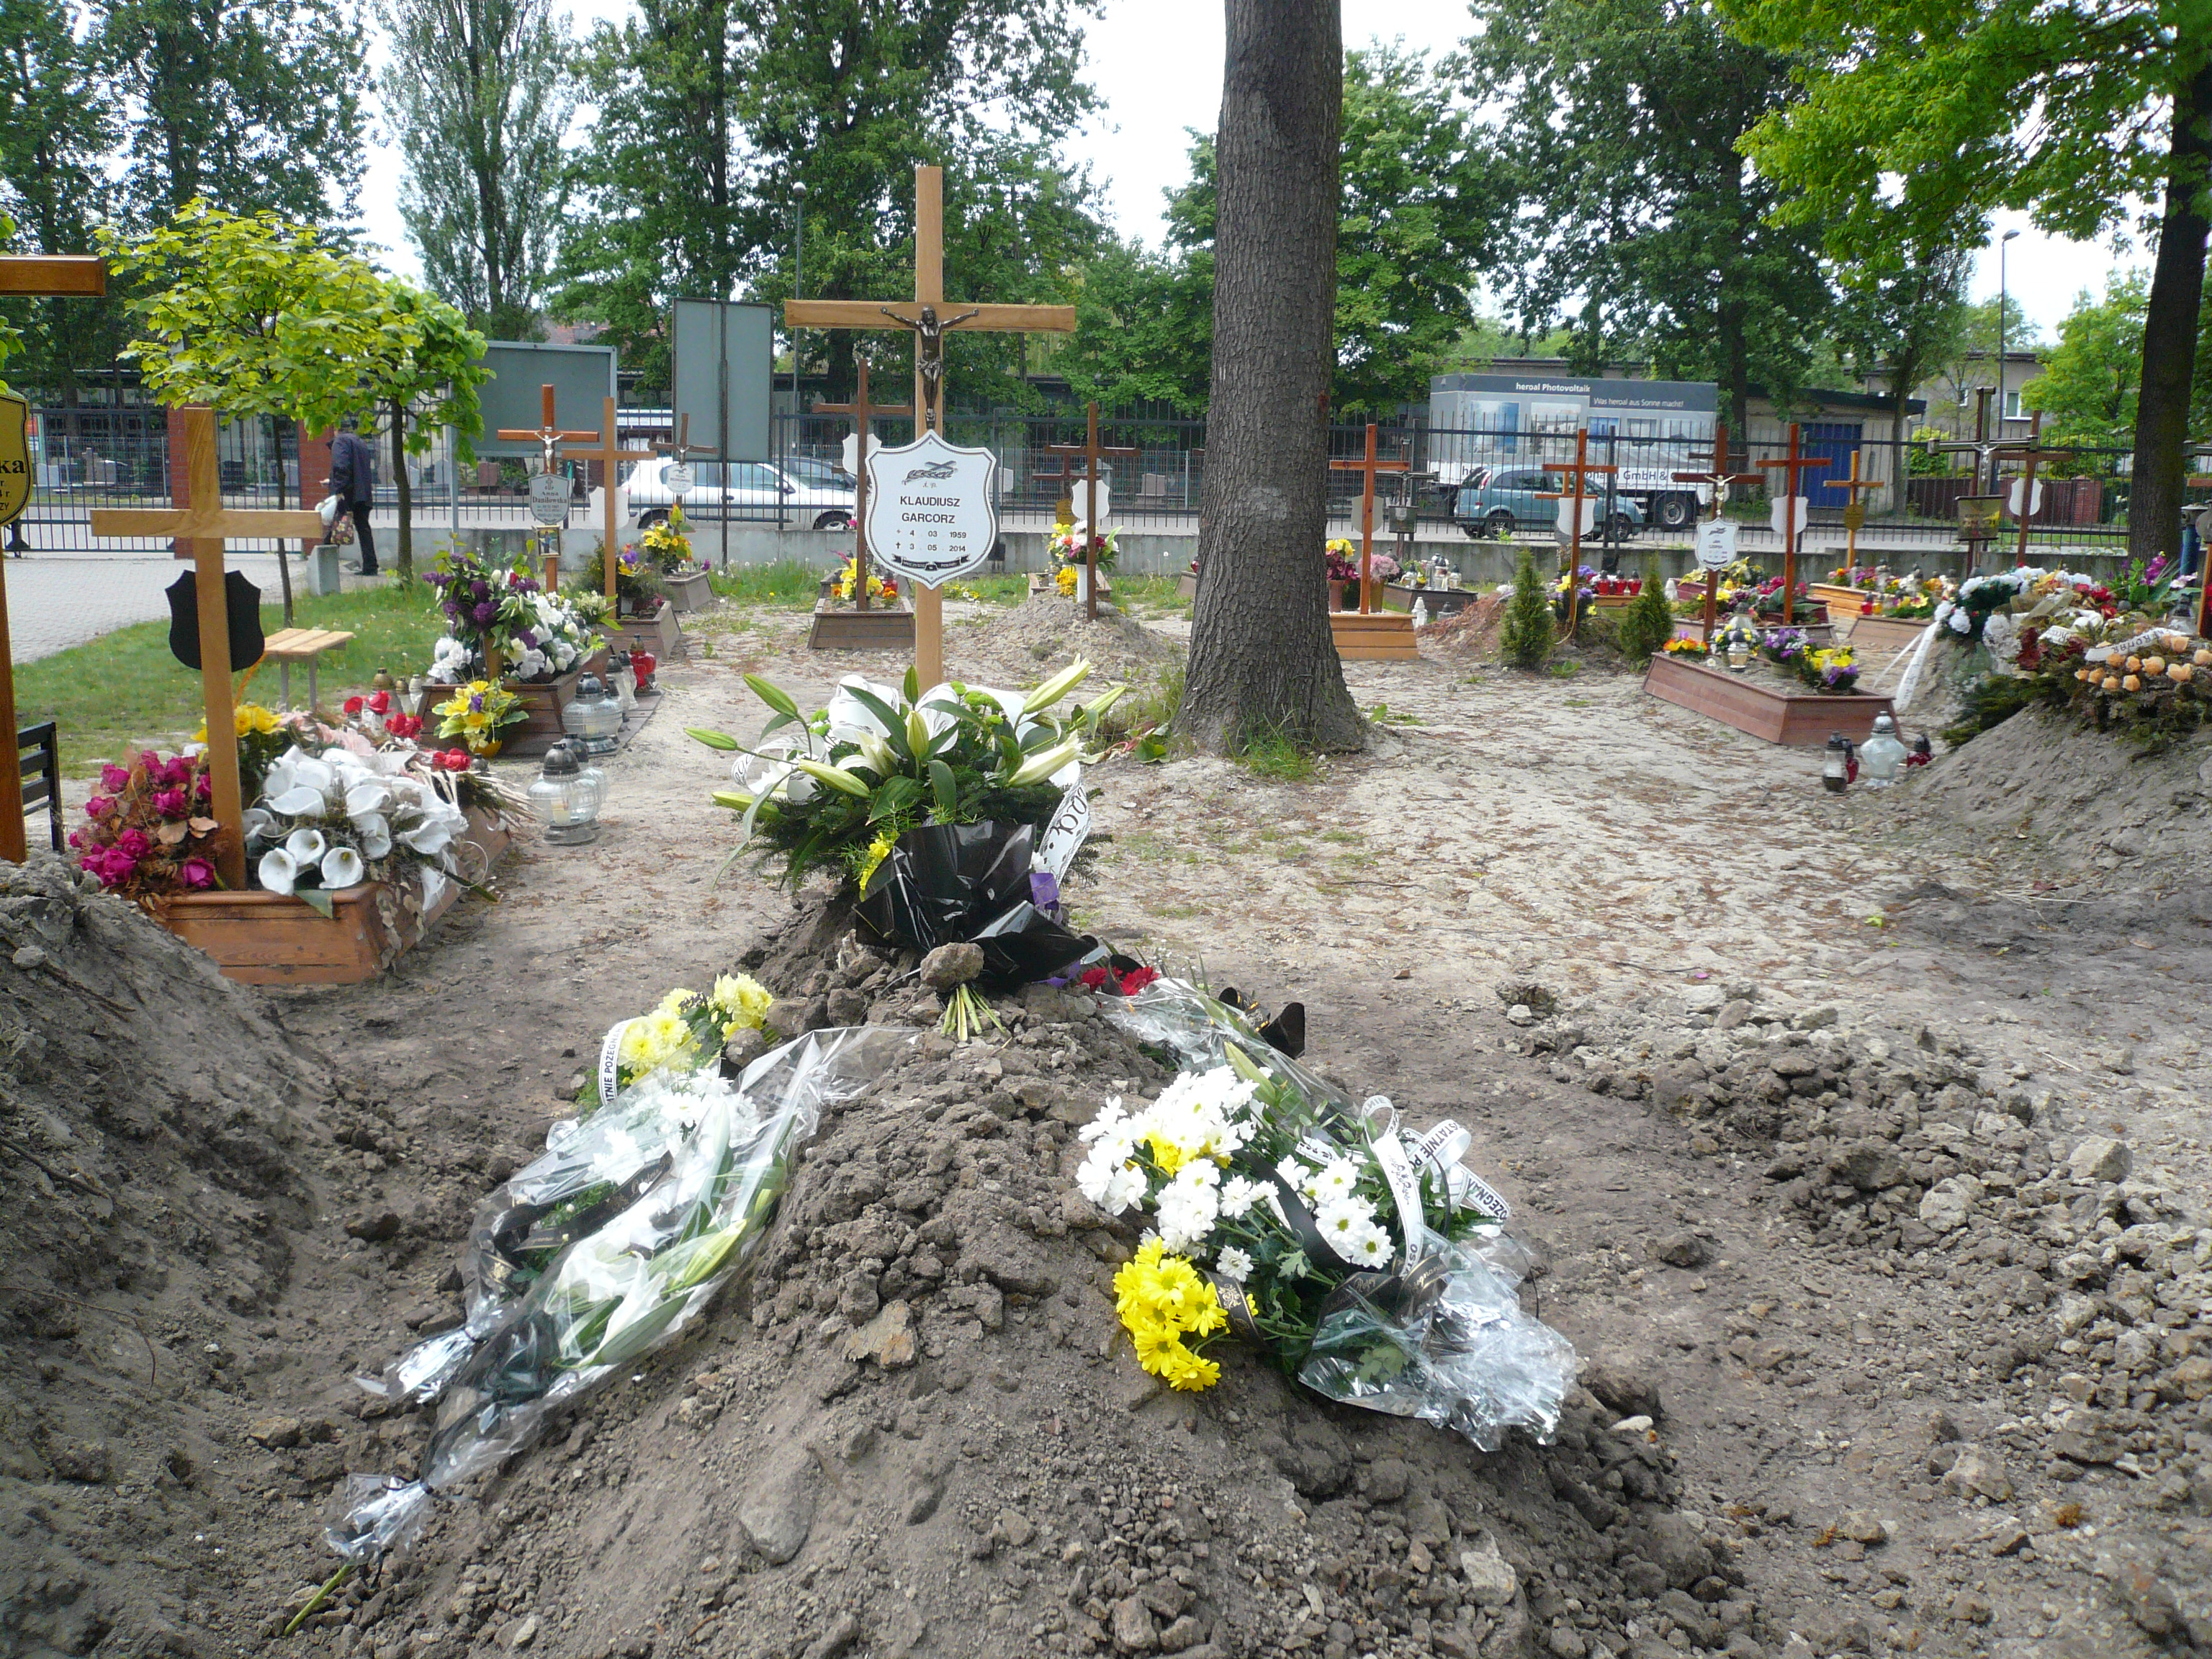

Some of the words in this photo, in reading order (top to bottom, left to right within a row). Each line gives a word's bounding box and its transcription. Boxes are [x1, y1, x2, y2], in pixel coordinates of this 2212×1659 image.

[1516, 382, 1540, 391] heroal
[1542, 383, 1591, 392] Photovoltaik
[1609, 397, 1628, 406] heroal
[1641, 398, 1660, 407] Sonne
[1624, 470, 1656, 480] GmbH
[900, 495, 961, 507] KLAUDIUSZ
[902, 512, 956, 523] GARCORZ
